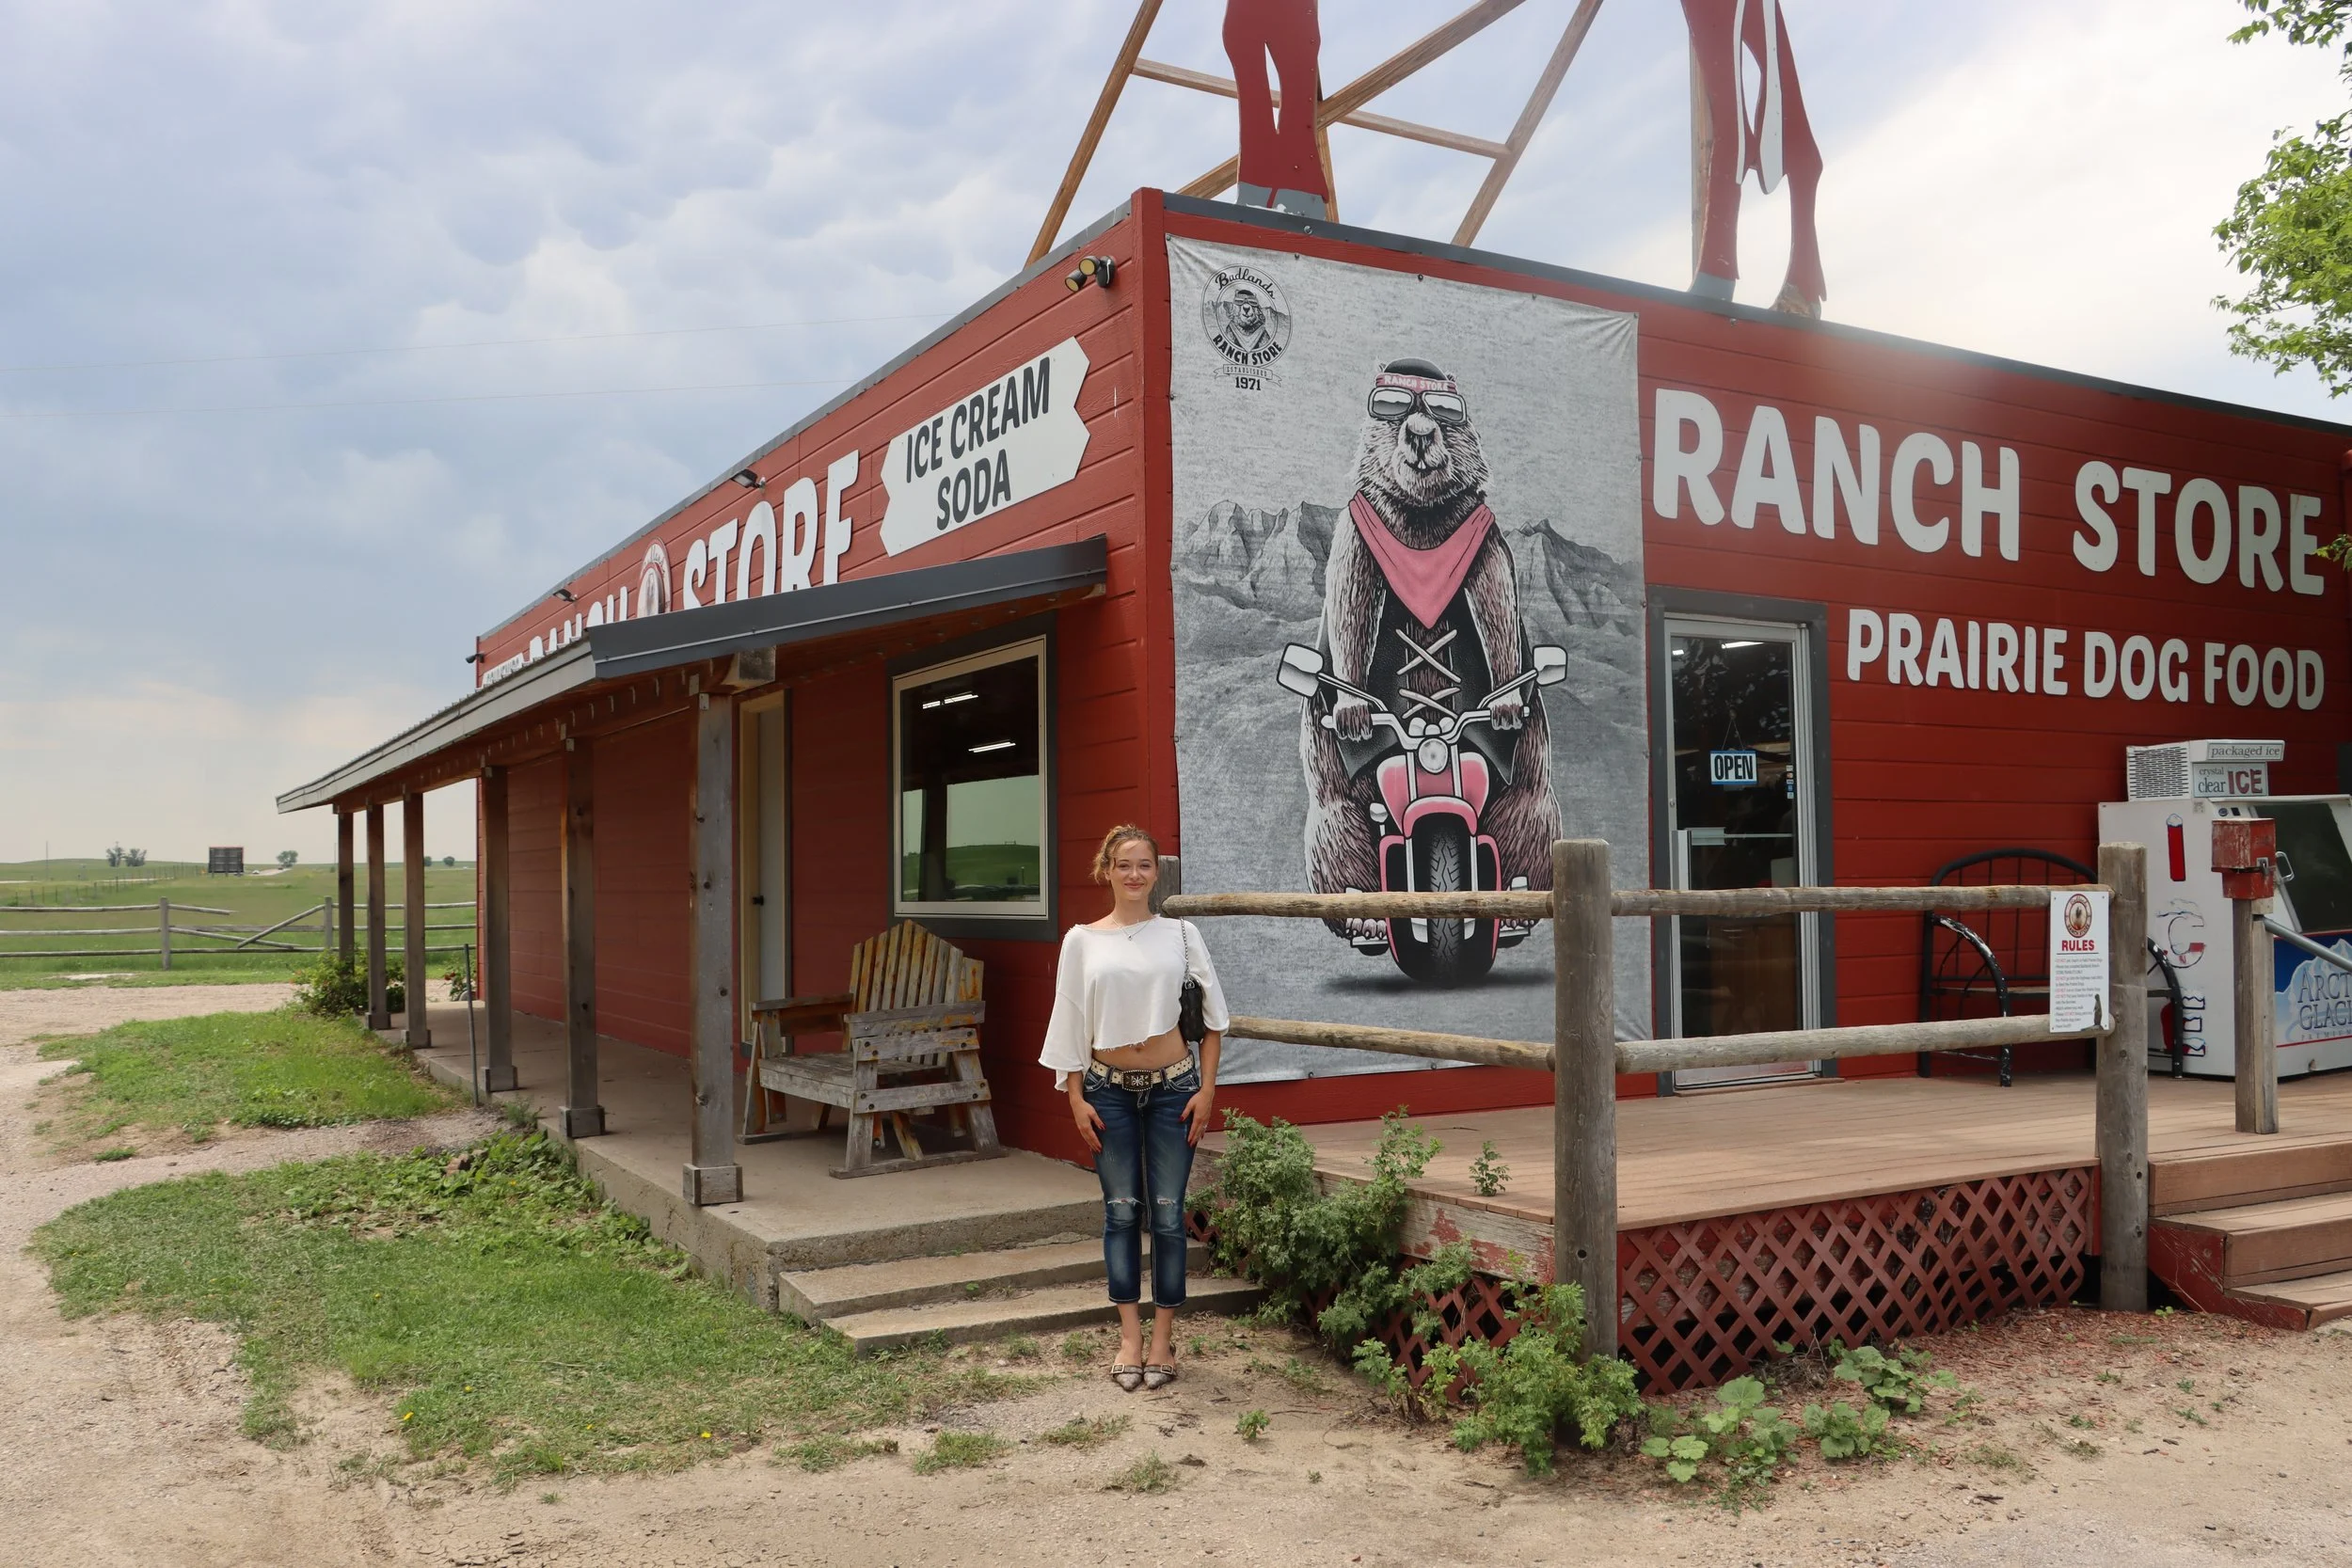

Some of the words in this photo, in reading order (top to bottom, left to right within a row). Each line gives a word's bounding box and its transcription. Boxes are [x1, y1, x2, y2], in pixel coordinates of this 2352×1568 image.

[1215, 267, 1275, 300] Badlands
[1213, 334, 1248, 365] RANCH
[1252, 341, 1282, 366] STORE
[1226, 366, 1267, 377] ESTABLISHED
[1234, 376, 1262, 391] 1971
[1384, 375, 1417, 388] RANCH
[1420, 380, 1450, 391] STORE
[906, 418, 944, 483] ICE
[949, 356, 1051, 460] CREAM
[936, 449, 1011, 531] SODA
[1652, 388, 2021, 562] RANCH
[2073, 460, 2325, 596] STORE
[1847, 609, 2068, 696] PRAIRIE
[2083, 631, 2190, 703] DOG
[2203, 642, 2326, 711] FOOD
[2211, 746, 2263, 758] packaged
[2265, 746, 2280, 756] ice
[1714, 754, 1754, 781] OPEN
[2199, 767, 2224, 777] crystal
[2227, 768, 2264, 795] ICE
[2198, 777, 2226, 793] clear
[2061, 940, 2095, 952] RULES
